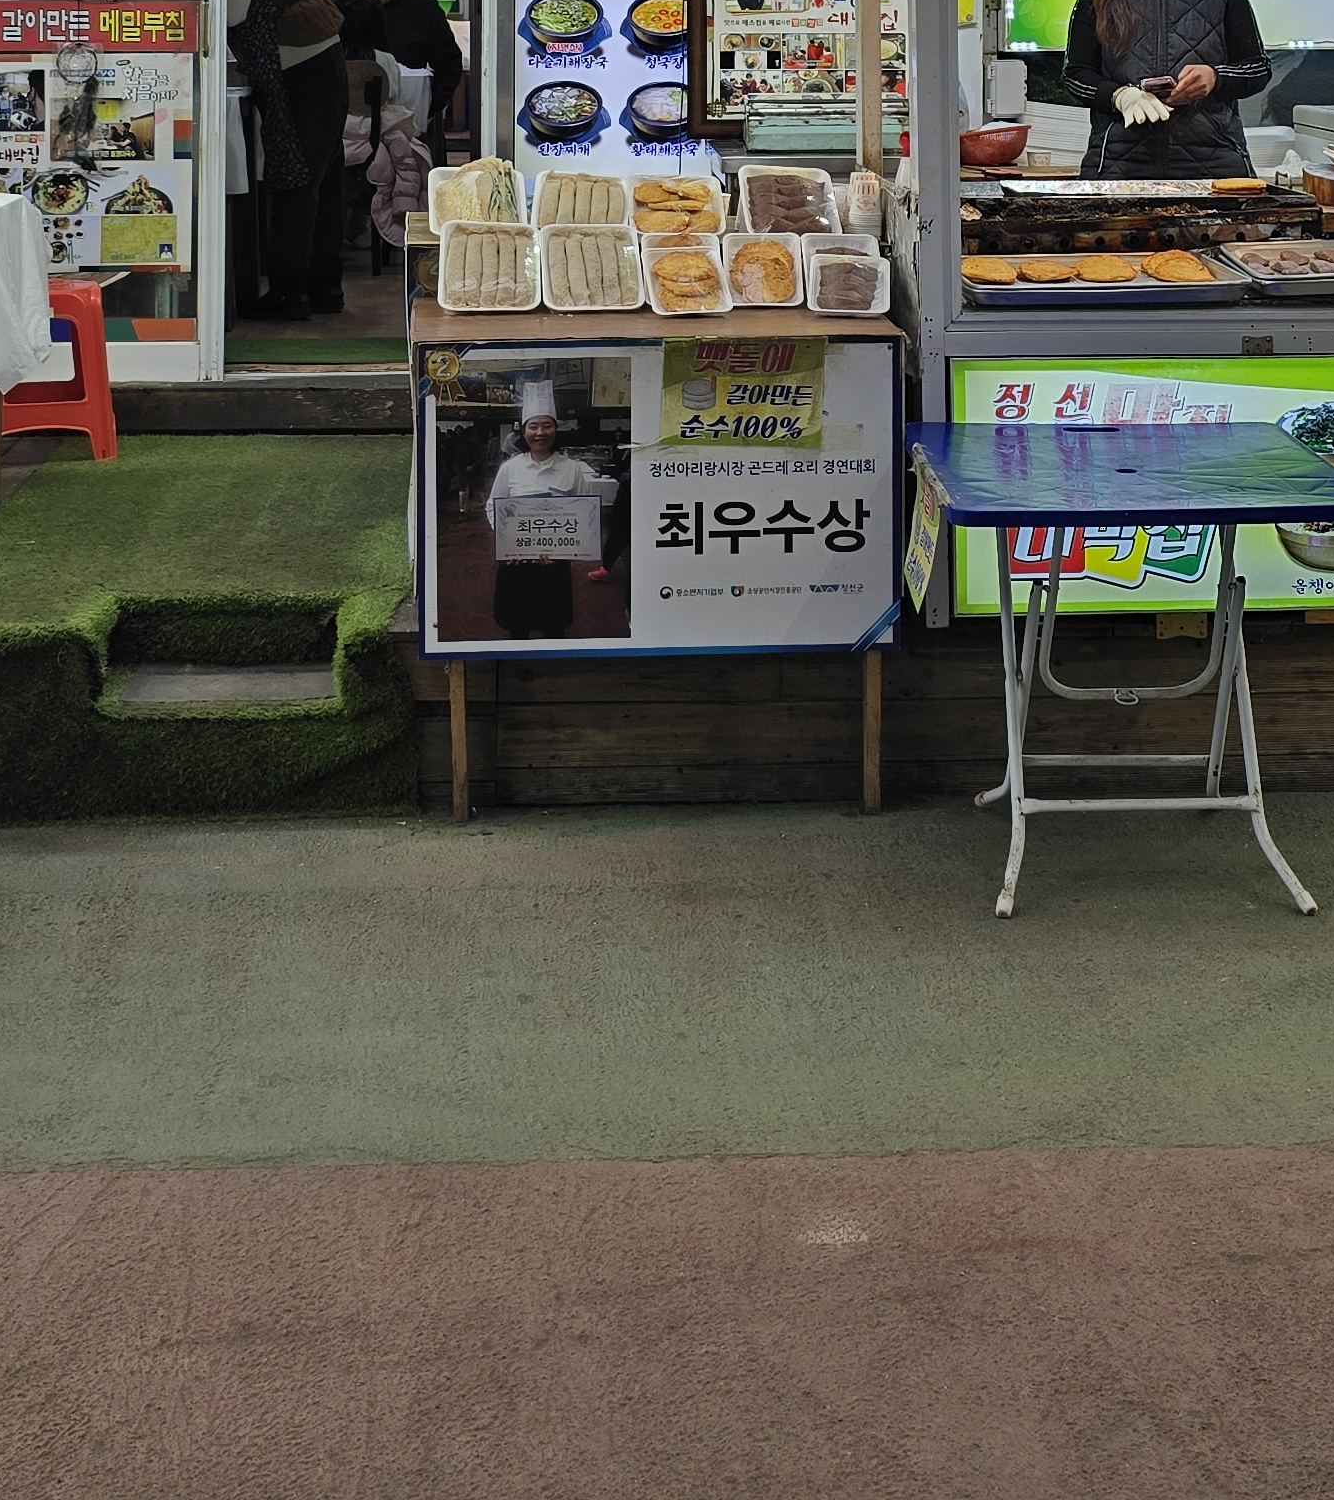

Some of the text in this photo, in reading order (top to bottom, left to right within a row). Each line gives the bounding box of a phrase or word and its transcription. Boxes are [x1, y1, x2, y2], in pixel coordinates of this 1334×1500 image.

[1, 8, 91, 43] 갈아만든
[99, 8, 185, 44] 메밀부침
[725, 382, 813, 408] 갈아만든
[993, 382, 1095, 422] 정선
[679, 415, 805, 441] 순수100%
[649, 458, 877, 478] 정선아리랑시장 곤드레 요리 경연대회
[516, 518, 579, 534] 최우수상
[655, 499, 871, 556] 최우수상
